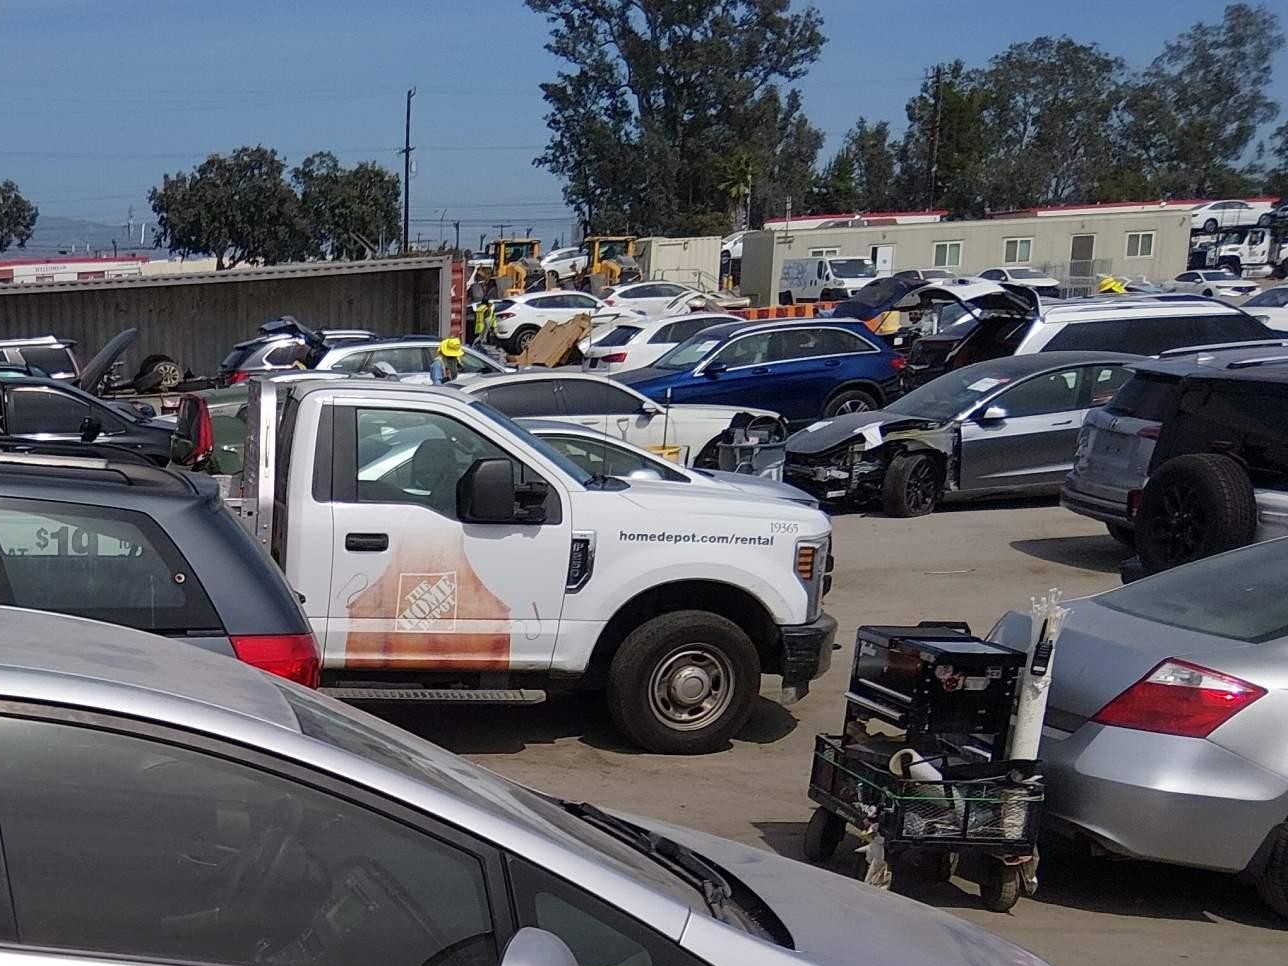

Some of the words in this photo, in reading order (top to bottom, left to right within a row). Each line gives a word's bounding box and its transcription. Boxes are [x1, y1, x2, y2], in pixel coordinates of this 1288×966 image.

[619, 530, 775, 547] homedepot.com/rental
[769, 522, 799, 534] 19365
[397, 575, 456, 630] HOME
[404, 579, 432, 605] THE
[417, 594, 456, 631] DEPOT
